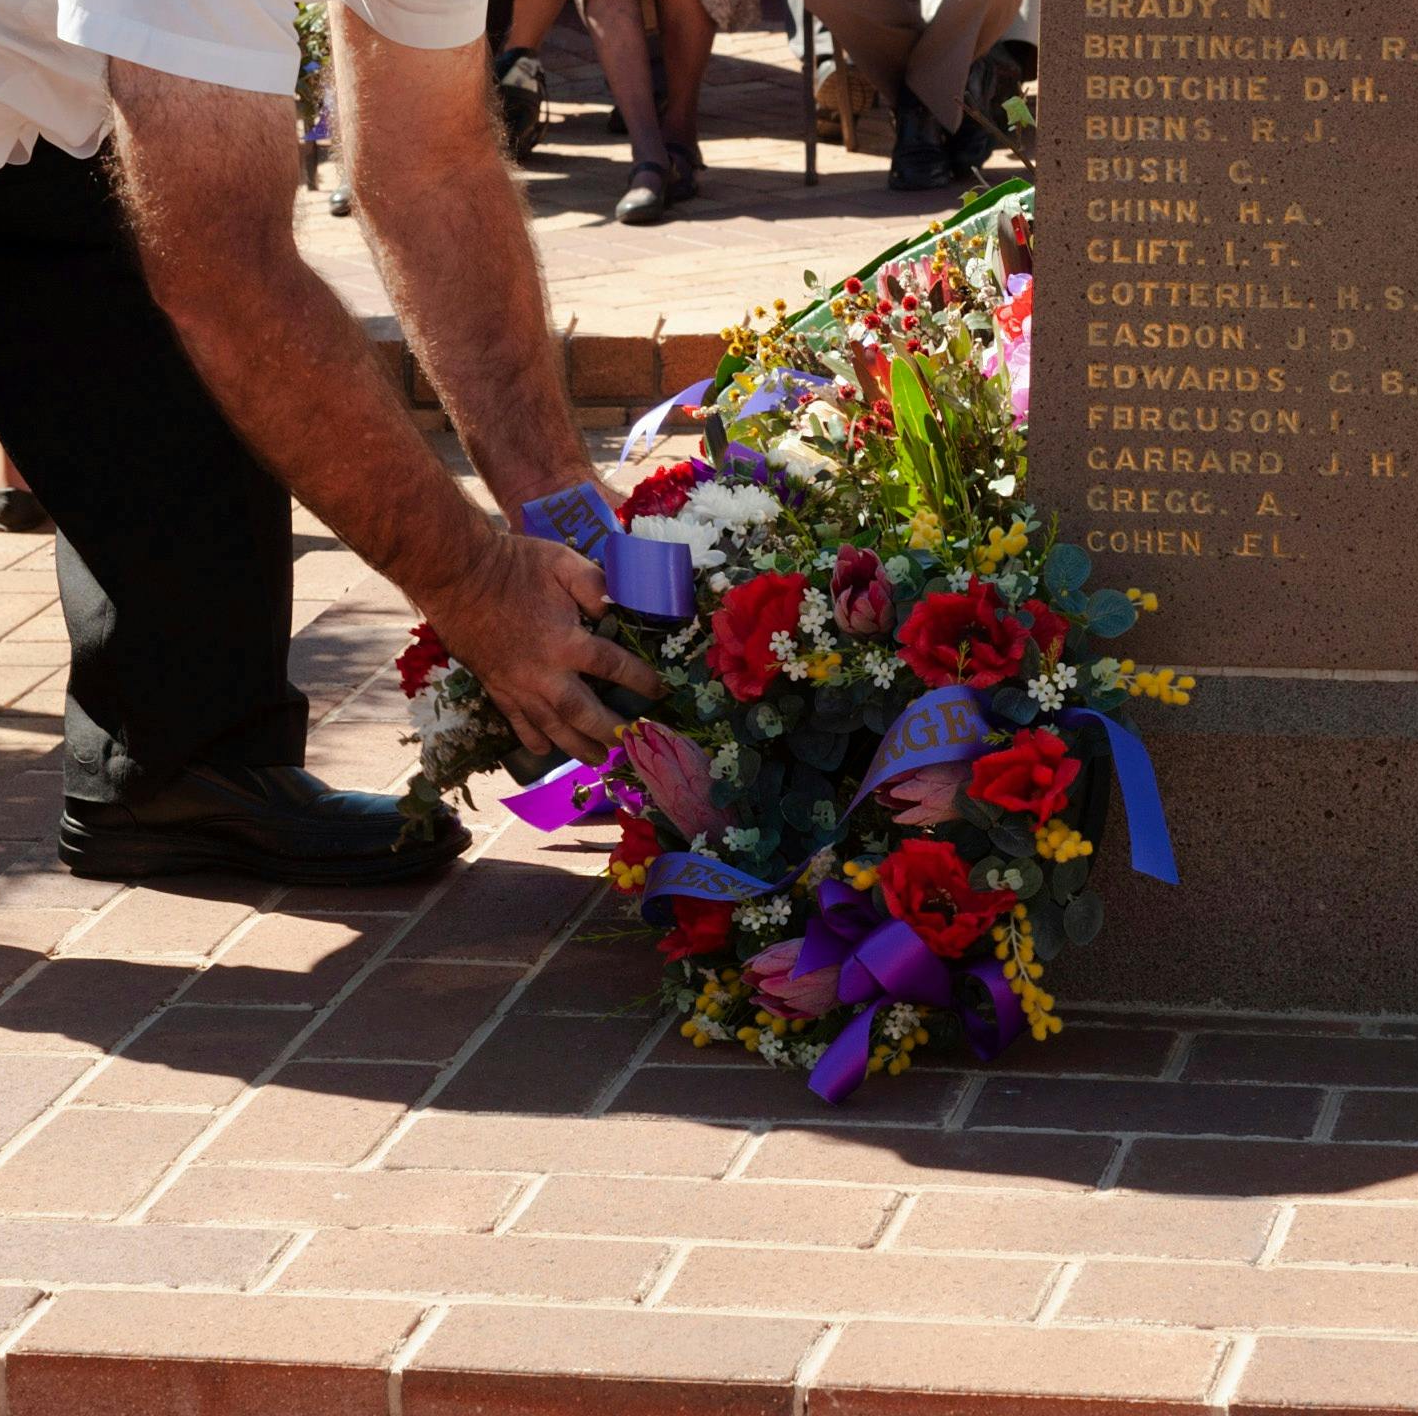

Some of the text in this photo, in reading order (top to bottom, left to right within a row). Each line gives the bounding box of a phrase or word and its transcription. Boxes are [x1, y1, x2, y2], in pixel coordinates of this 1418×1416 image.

[1084, 34, 1362, 61] BRITTINGHAM.
[1085, 76, 1280, 102] BROTCHIE.
[1085, 116, 1229, 143] BURNS.
[1087, 200, 1211, 224] CHINN.
[1087, 239, 1206, 265] CLIFT.
[1087, 282, 1316, 309] COTTERILL.
[1087, 322, 1261, 349] EASDON.
[1087, 364, 1302, 393] EDWARDS.
